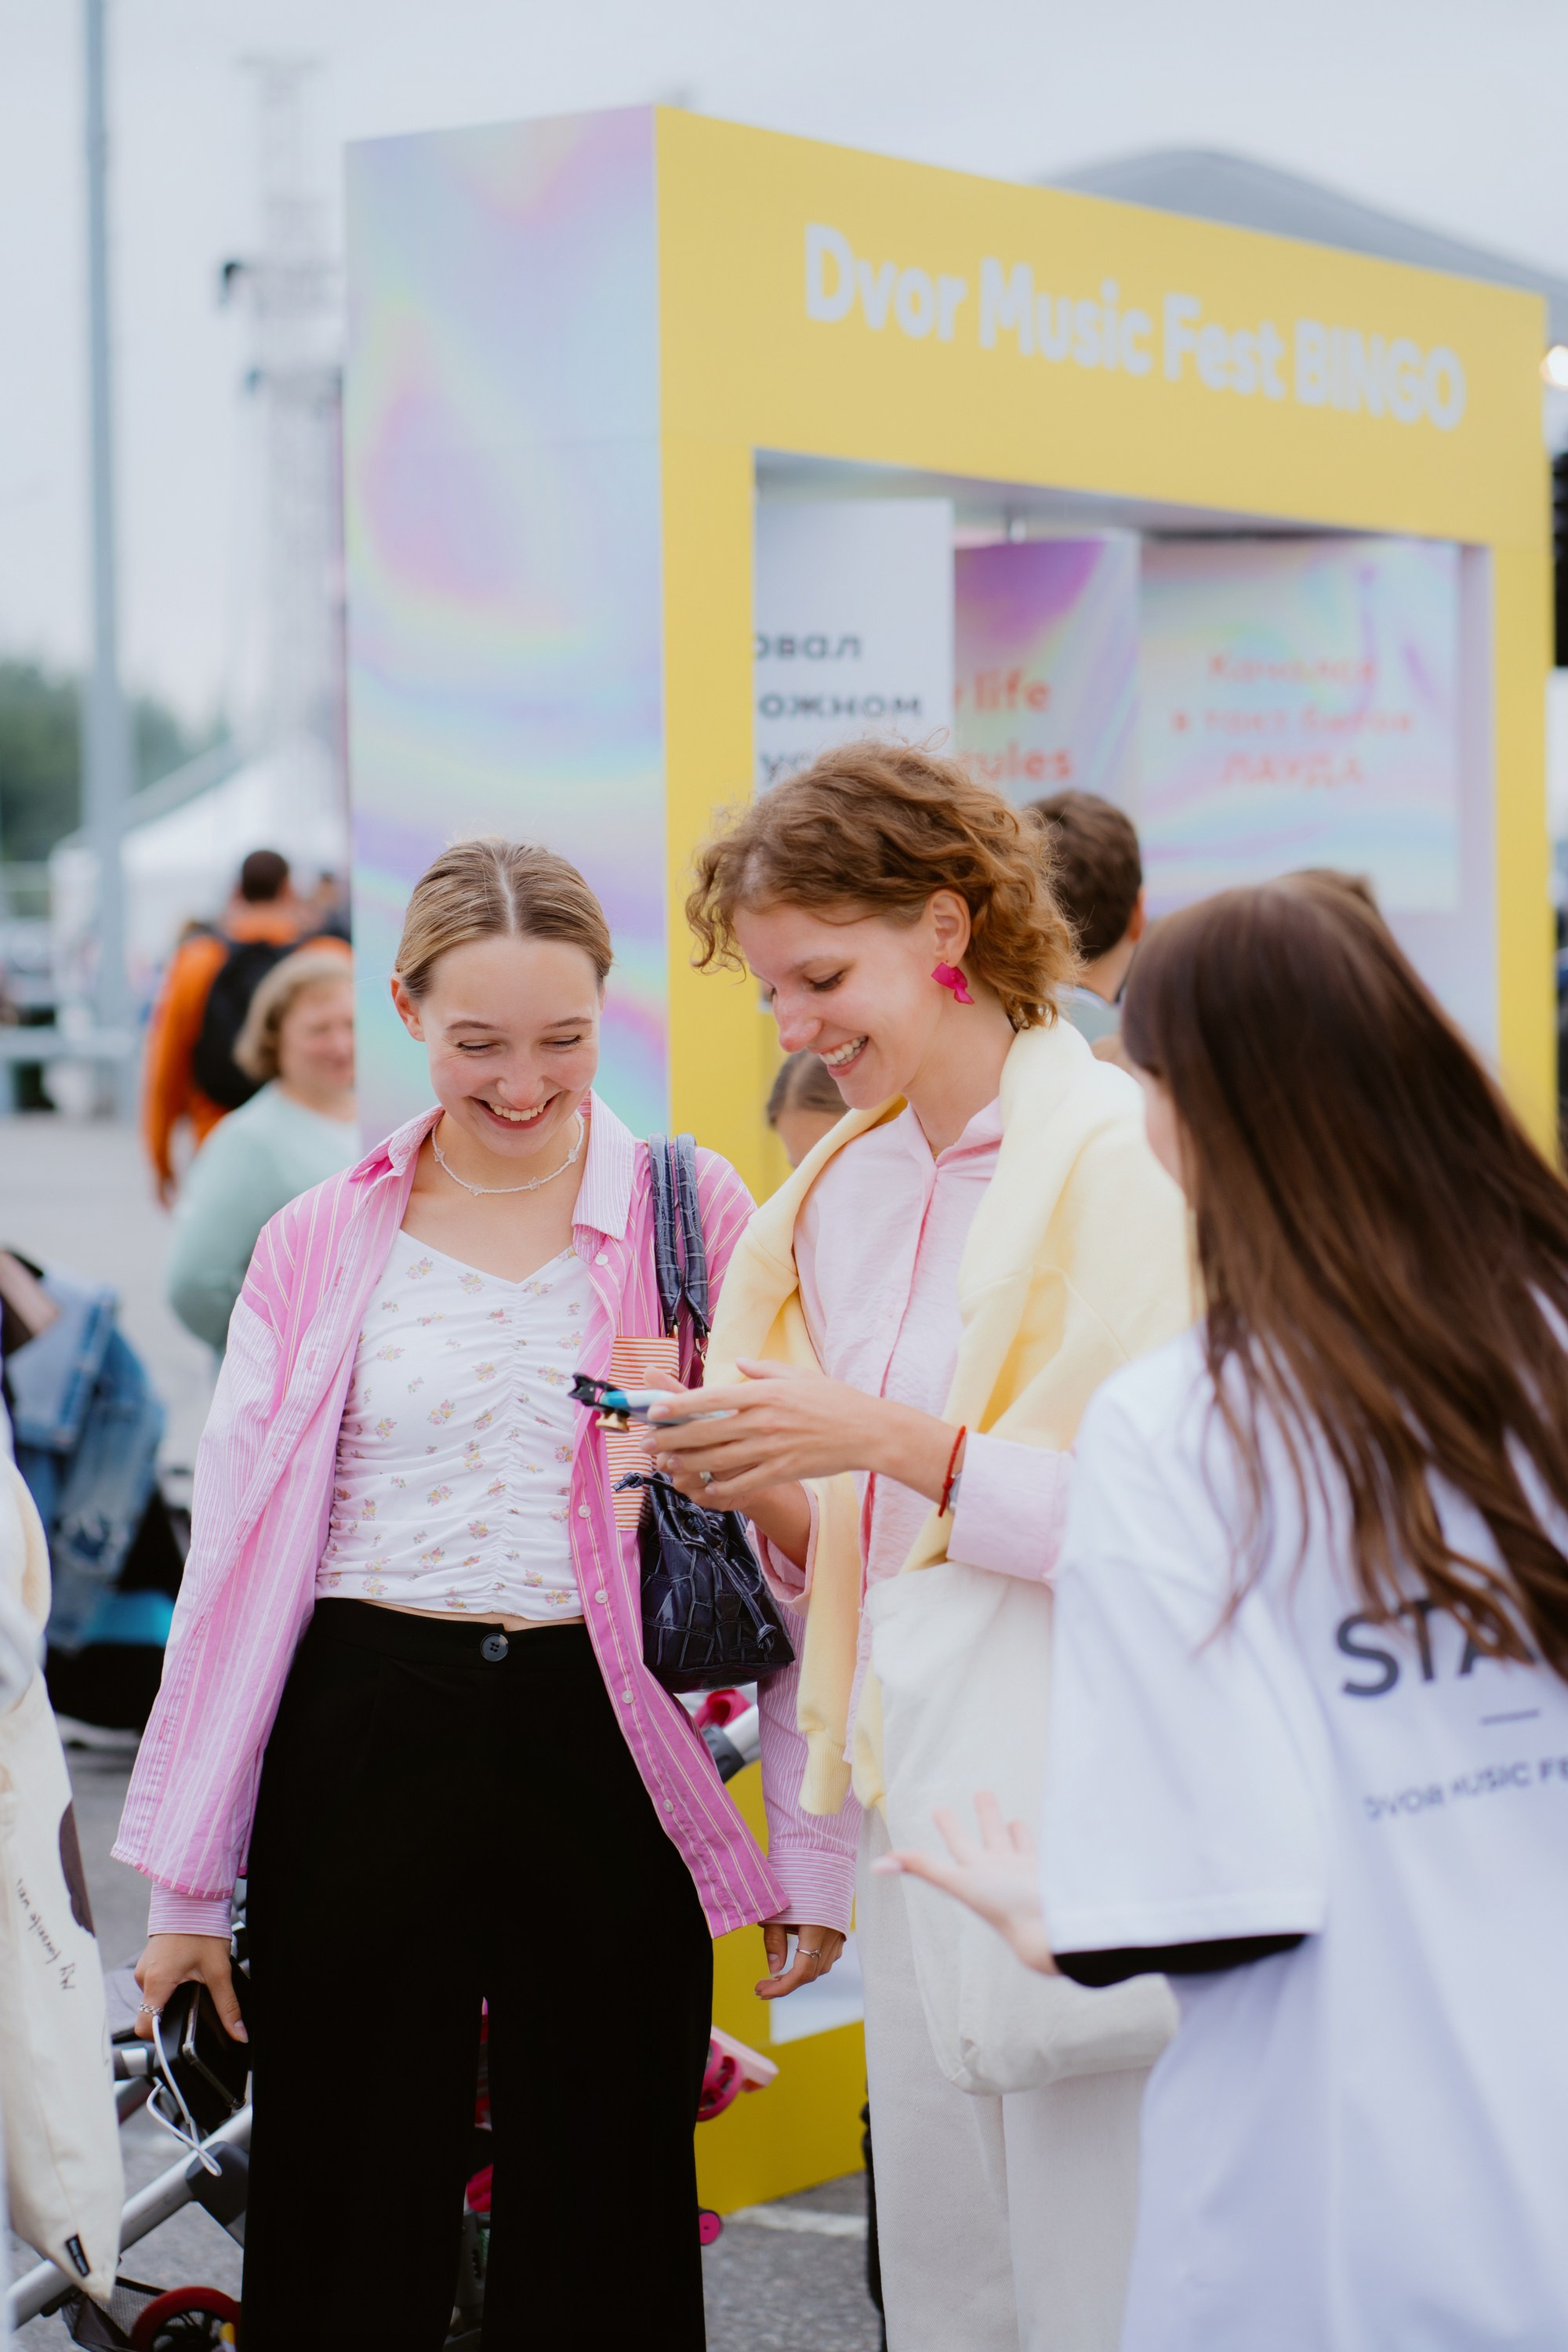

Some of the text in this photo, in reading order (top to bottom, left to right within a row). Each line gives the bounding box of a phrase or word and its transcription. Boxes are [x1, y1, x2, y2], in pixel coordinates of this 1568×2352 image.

[804, 222, 1466, 432] Dvor Music Fest BINGO
[974, 669, 1052, 713] life
